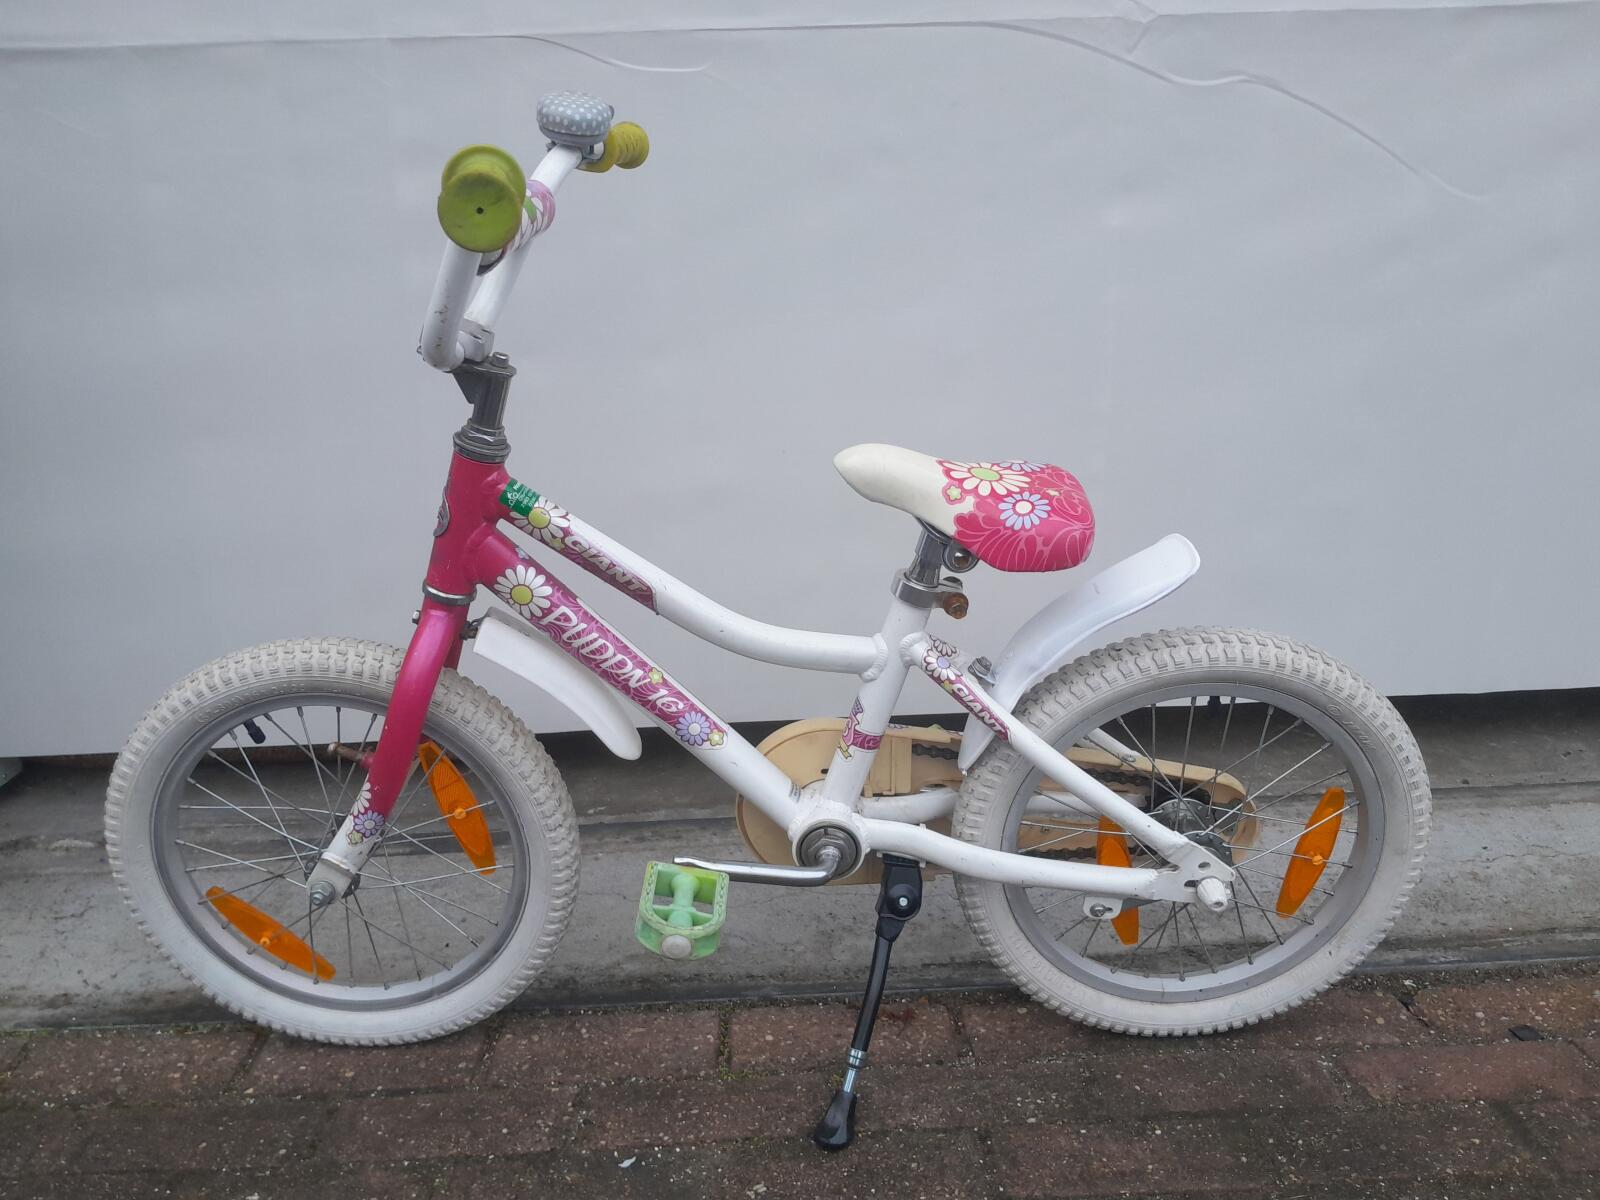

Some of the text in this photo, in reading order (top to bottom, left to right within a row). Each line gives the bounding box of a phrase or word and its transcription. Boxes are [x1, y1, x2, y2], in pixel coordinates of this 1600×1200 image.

[564, 535, 647, 592] GIANT
[648, 689, 684, 713] 16
[951, 683, 1005, 733] GIANT
